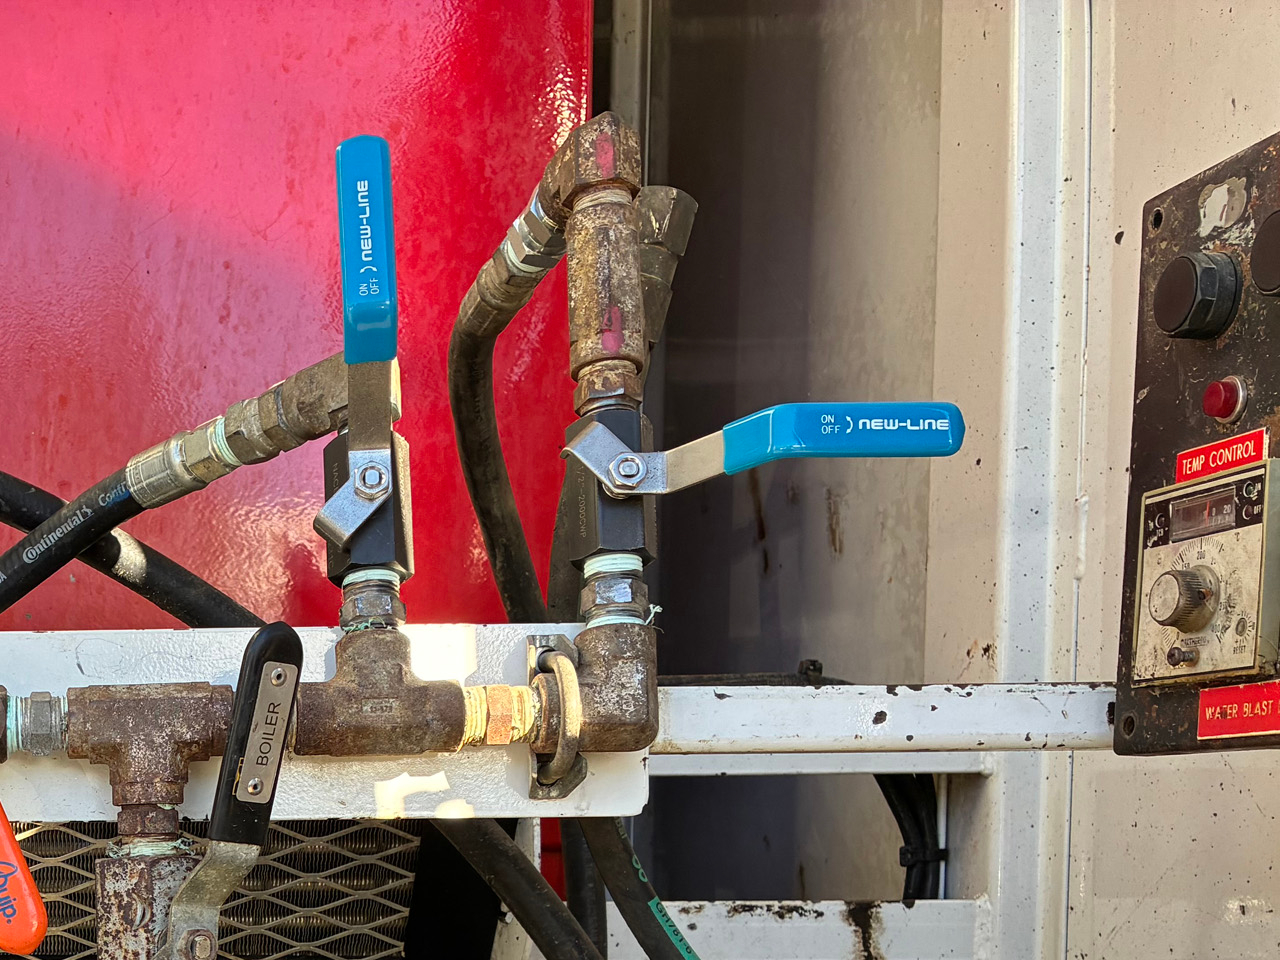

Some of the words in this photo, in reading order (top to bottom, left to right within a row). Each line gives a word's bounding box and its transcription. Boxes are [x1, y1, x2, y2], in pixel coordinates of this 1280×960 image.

[359, 283, 369, 296] ON
[369, 277, 380, 295] OFF
[821, 414, 835, 424] ON
[821, 425, 840, 434] OFF
[1182, 455, 1206, 476] TEMP
[1209, 440, 1257, 468] CONTROL
[22, 510, 84, 564] Continental
[1242, 699, 1274, 718] BLAST
[255, 701, 282, 767] BOILER
